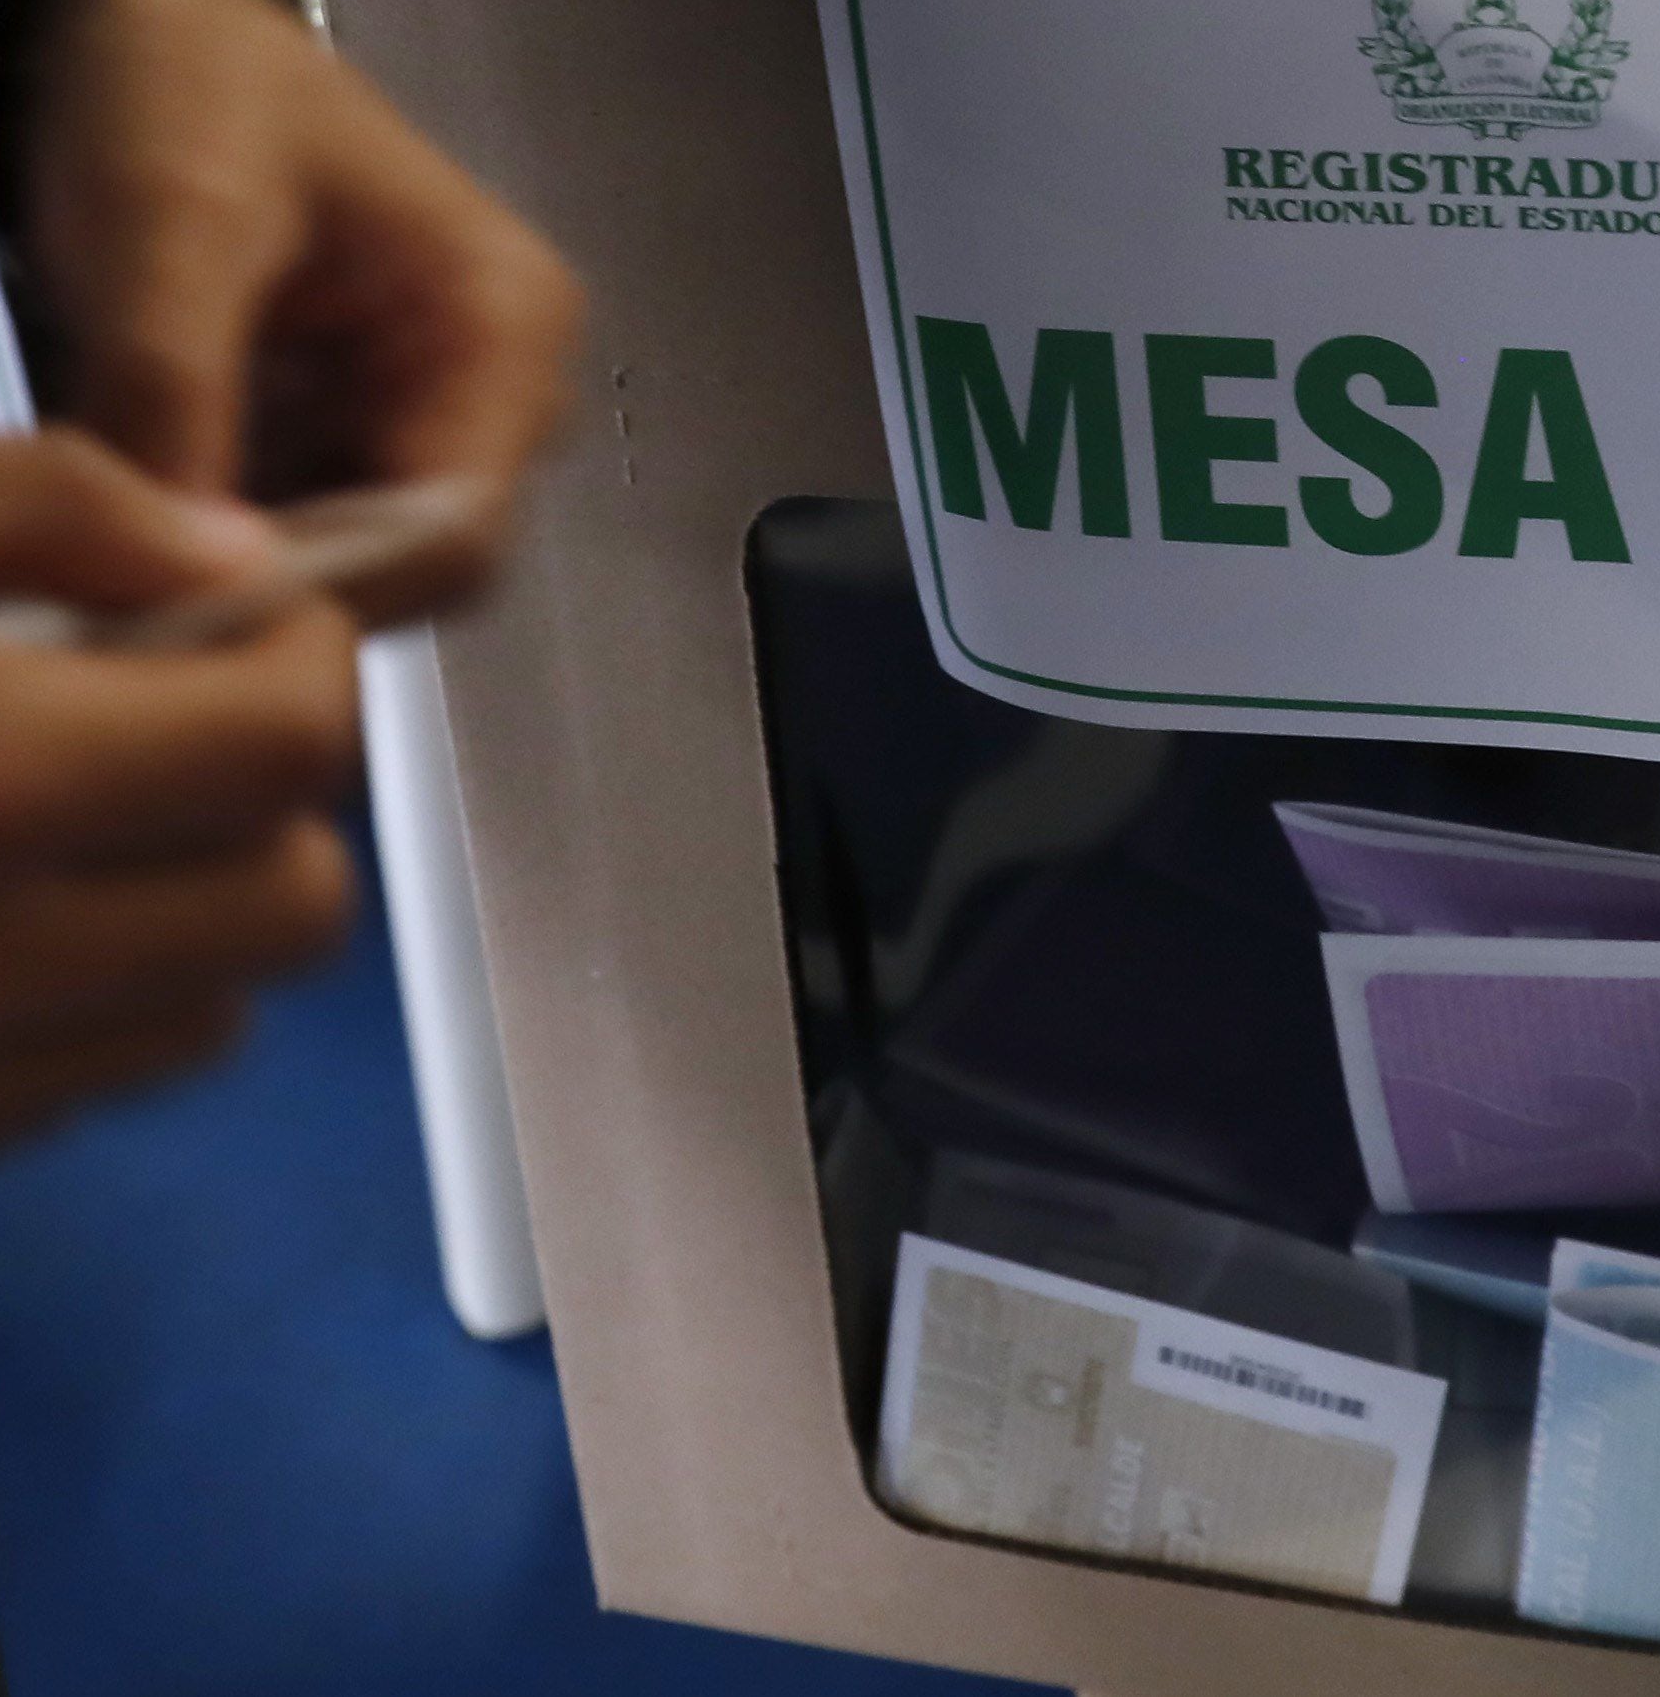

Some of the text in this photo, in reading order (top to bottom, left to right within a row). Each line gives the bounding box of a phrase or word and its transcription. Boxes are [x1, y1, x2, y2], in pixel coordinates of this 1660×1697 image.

[1227, 197, 1414, 225] NACIONAL
[1429, 203, 1503, 230] DEL
[915, 313, 1632, 565] MESA
